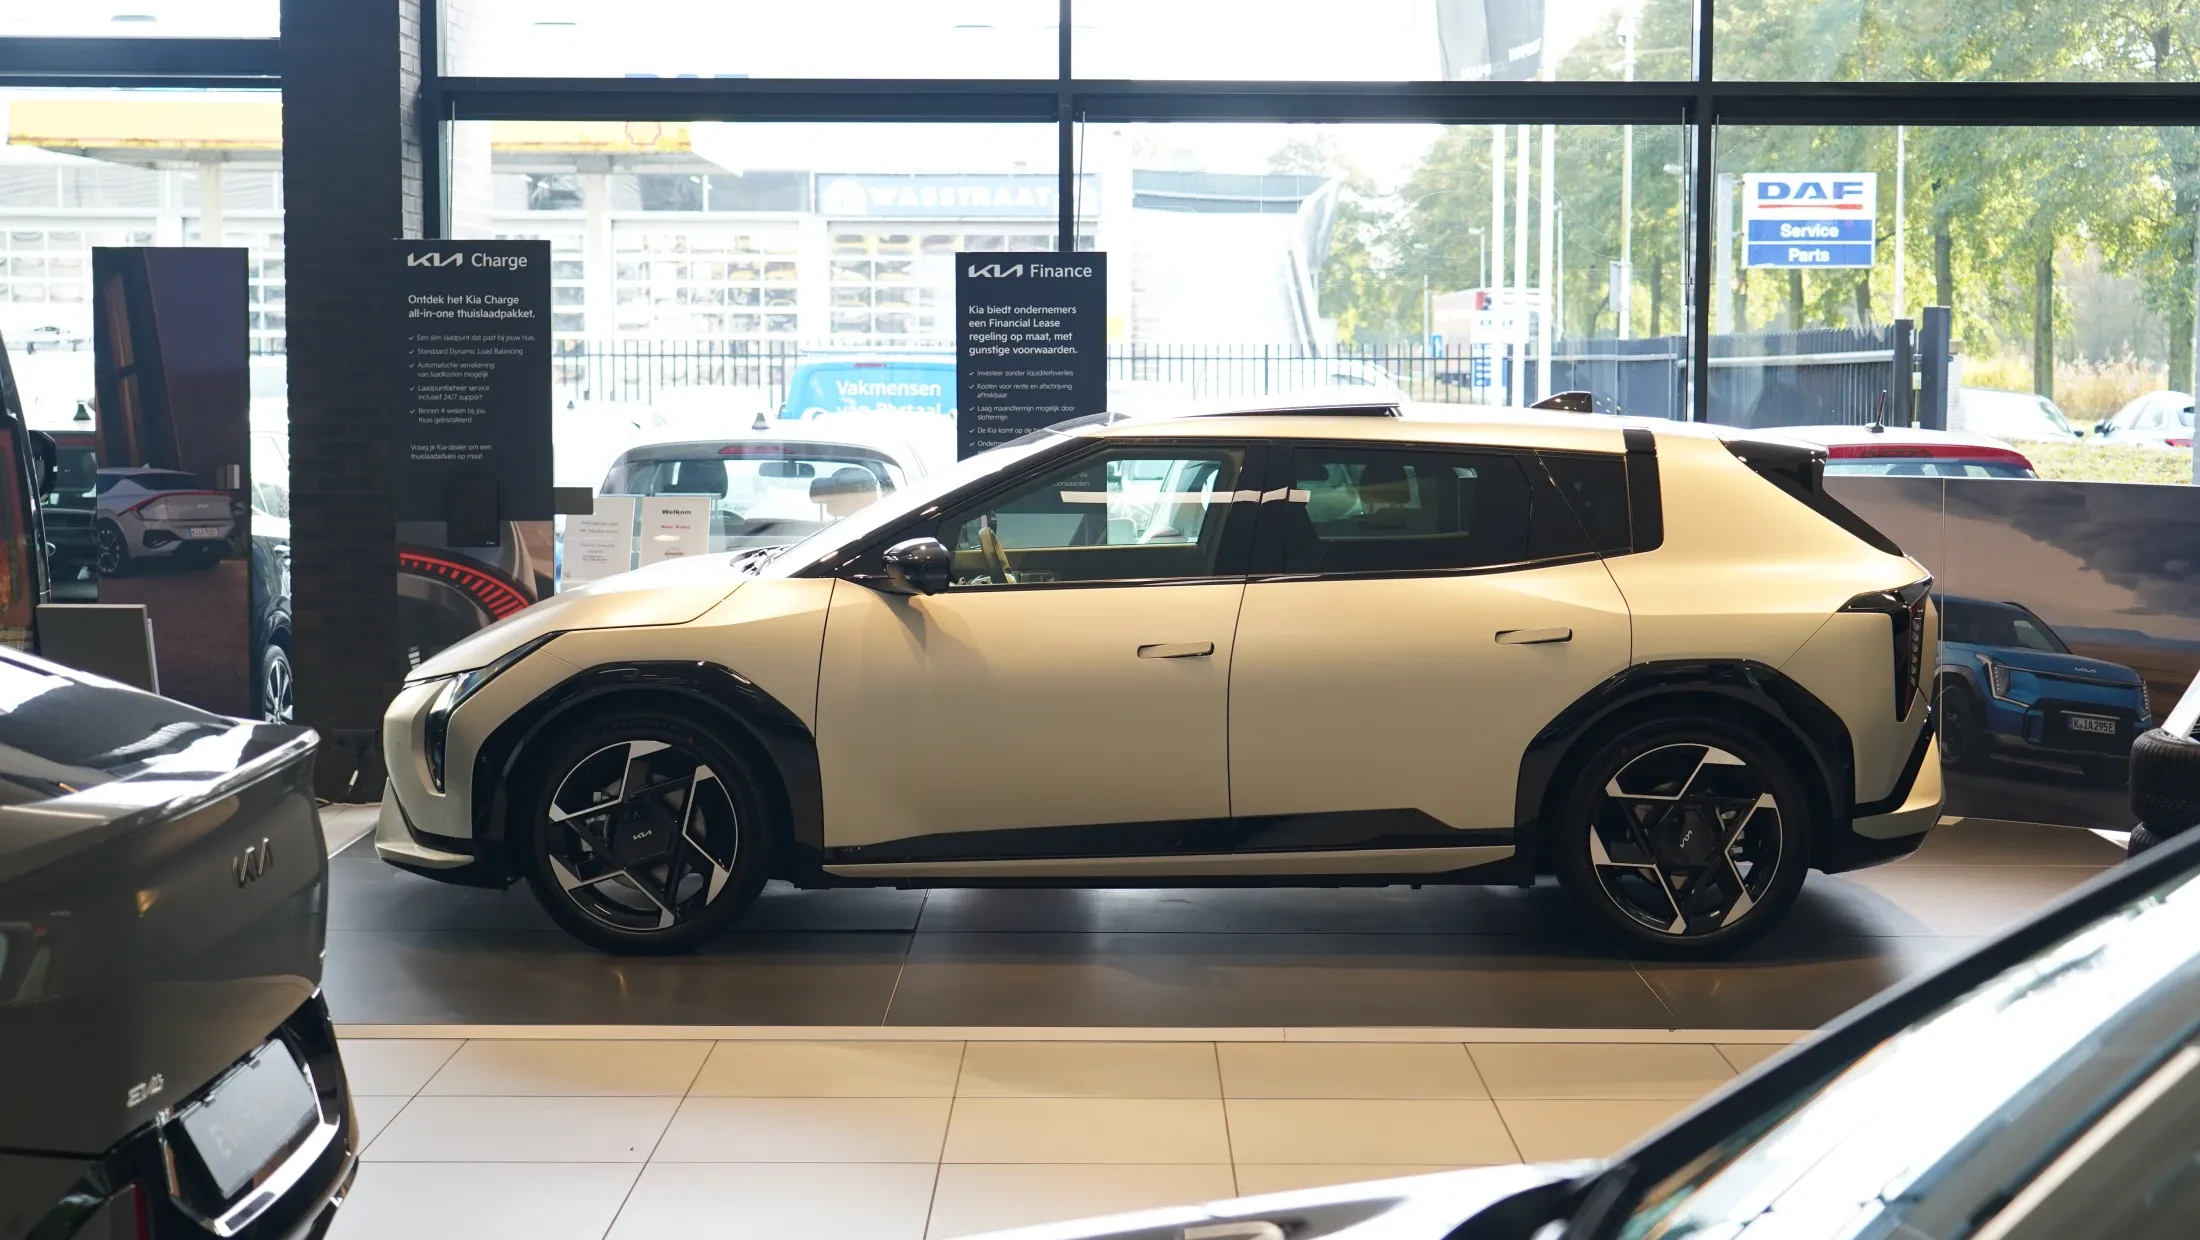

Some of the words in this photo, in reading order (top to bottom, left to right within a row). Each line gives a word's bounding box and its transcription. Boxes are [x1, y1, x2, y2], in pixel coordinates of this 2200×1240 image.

[867, 185, 1052, 208] WASSTRAAT
[1757, 182, 1864, 200] DAF
[1780, 223, 1839, 238] Service
[471, 252, 528, 270] Charge
[1788, 248, 1830, 262] Parts
[1030, 264, 1092, 278] Finance
[408, 294, 444, 304] Ontdek
[447, 294, 464, 304] het
[466, 294, 482, 304] Kia
[484, 294, 520, 306] Charge
[408, 308, 454, 318] all-in-one
[457, 308, 536, 320] thuislaadpakket.
[968, 306, 984, 314] Kia
[986, 305, 1012, 314] biedt
[1014, 305, 1076, 314] ondernemers
[989, 318, 1030, 328] Financial
[1033, 318, 1060, 328] Lease
[444, 334, 470, 342] laadpunt
[497, 334, 506, 342] bij
[968, 332, 1008, 342] regeling
[1010, 334, 1022, 342] op
[1026, 332, 1052, 342] maat,
[1054, 332, 1072, 341] met
[450, 348, 476, 356] Dynamic
[494, 348, 524, 356] Balancing
[968, 345, 1010, 356] gunstige
[1012, 345, 1078, 354] voorwaarden.
[460, 362, 494, 370] verrekening
[464, 371, 488, 379] mogelijk
[836, 380, 942, 396] Vakmensen
